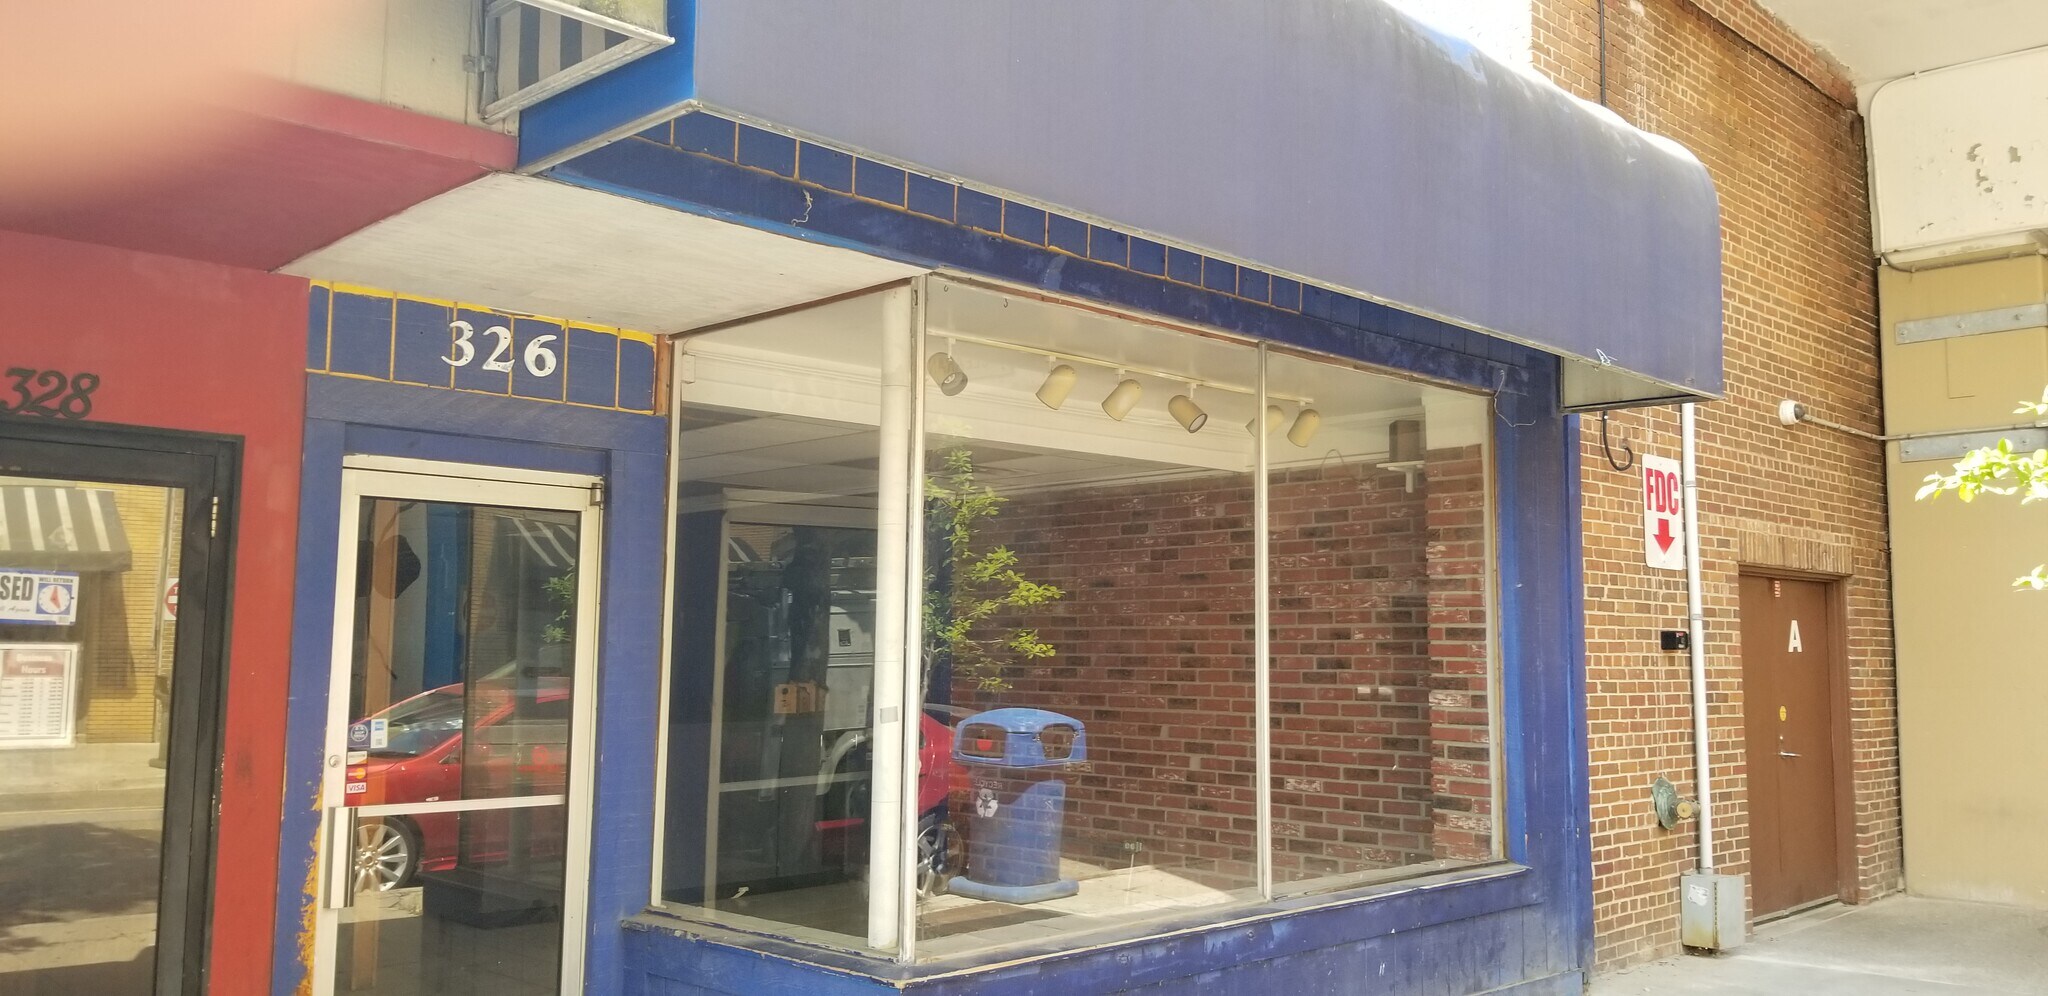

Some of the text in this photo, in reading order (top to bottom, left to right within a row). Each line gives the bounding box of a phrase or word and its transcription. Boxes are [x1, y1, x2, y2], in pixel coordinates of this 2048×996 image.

[441, 320, 557, 377] 326
[1, 367, 99, 419] 328
[1645, 467, 1679, 515] FDC
[0, 575, 34, 601] SED
[1788, 620, 1802, 652] A
